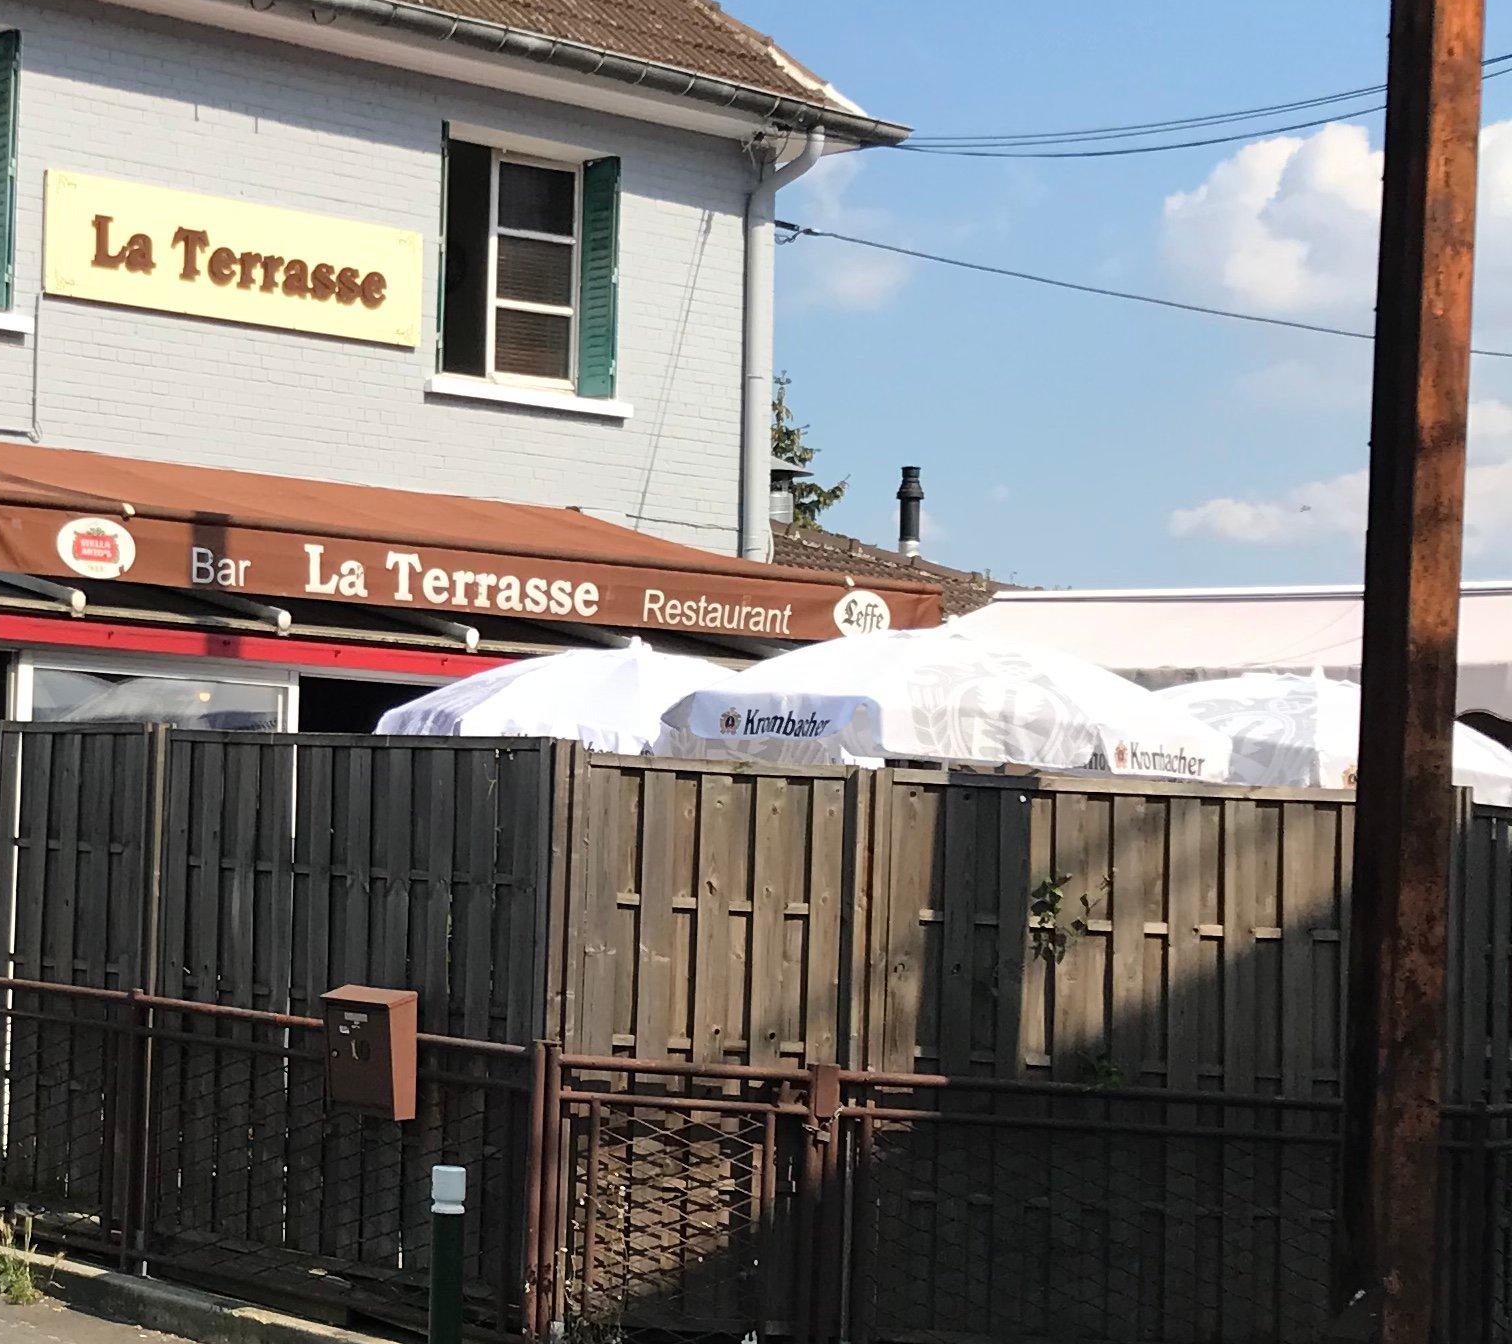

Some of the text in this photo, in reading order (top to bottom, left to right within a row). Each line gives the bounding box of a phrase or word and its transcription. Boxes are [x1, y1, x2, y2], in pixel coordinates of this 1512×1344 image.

[91, 214, 389, 310] La Terrasse
[191, 544, 884, 636] Bar La Terrasse Restaurant Leffe
